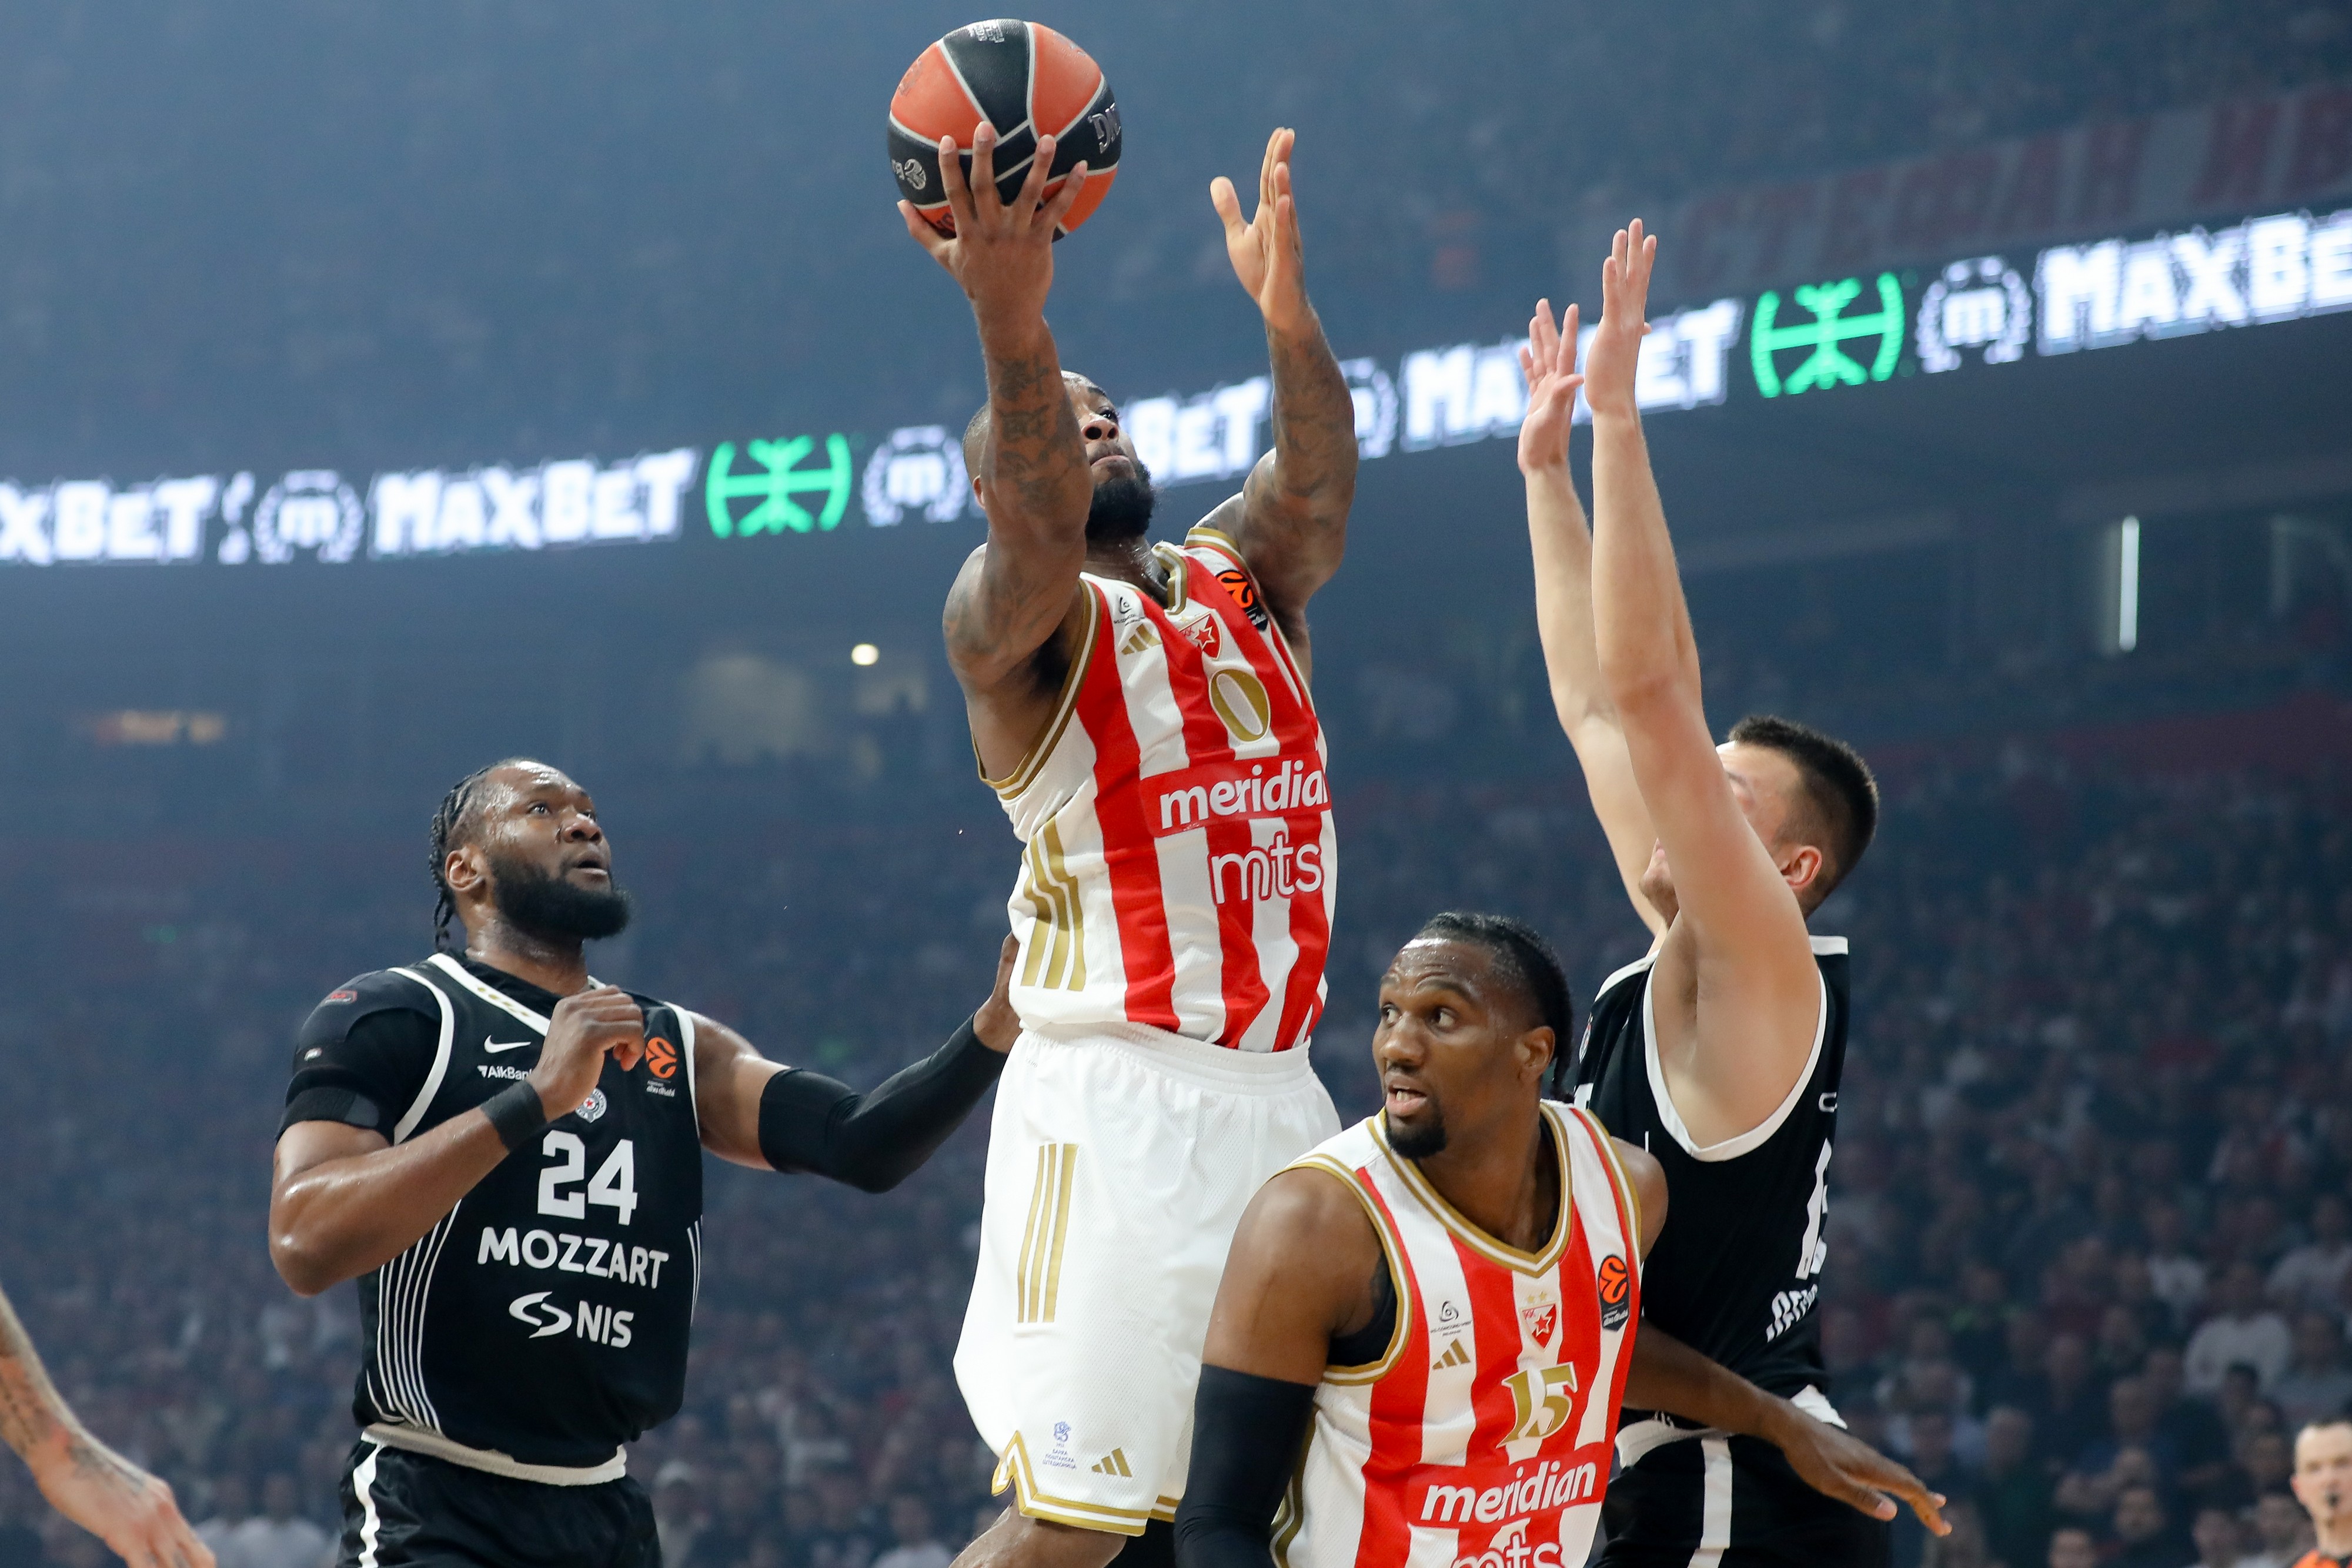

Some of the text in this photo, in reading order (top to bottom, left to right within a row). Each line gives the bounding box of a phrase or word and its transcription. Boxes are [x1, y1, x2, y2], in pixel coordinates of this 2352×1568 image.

[1402, 297, 1745, 452] MAET
[1120, 376, 1270, 487] BET
[370, 447, 700, 559] MAXBET
[1209, 668, 1271, 743] 0
[1159, 759, 1329, 830] meridia
[1211, 833, 1323, 905] mts
[487, 1065, 533, 1081] AikBan
[537, 1129, 638, 1226] 24
[477, 1226, 669, 1289] MOZZART
[576, 1300, 634, 1349] NIS
[1496, 1361, 1578, 1449] 15
[1420, 1460, 1597, 1523] meridian
